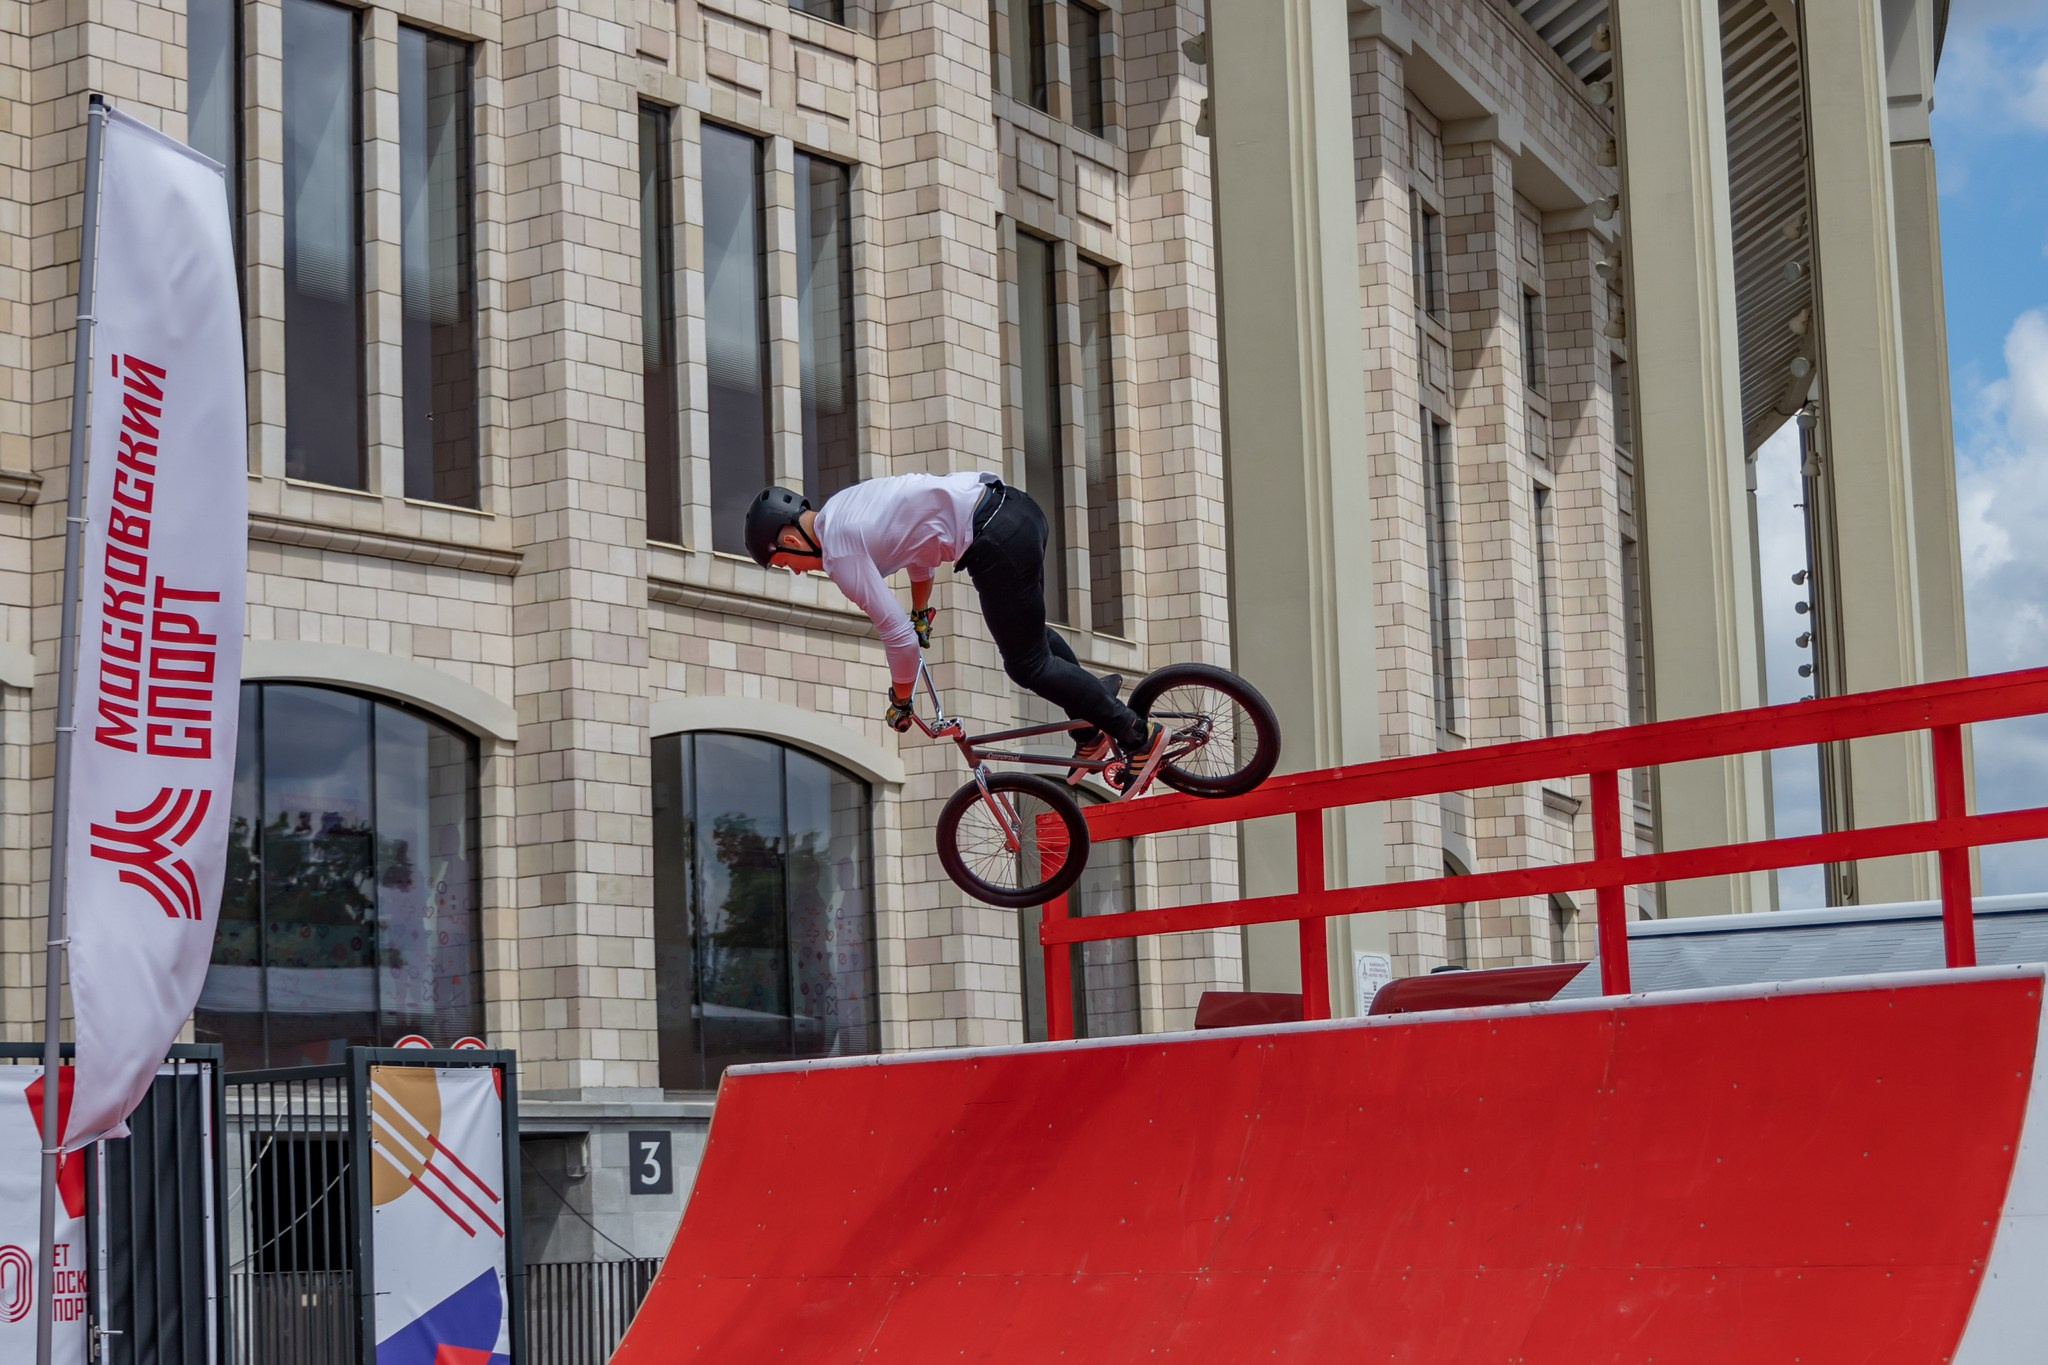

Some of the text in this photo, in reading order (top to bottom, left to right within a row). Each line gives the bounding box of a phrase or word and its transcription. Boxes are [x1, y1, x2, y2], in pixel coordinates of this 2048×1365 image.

[94, 353, 167, 753] МОСКОВСКИЙ
[146, 575, 221, 760] СПОРТ
[640, 1141, 662, 1186] 3
[53, 1243, 70, 1267] ЕТ
